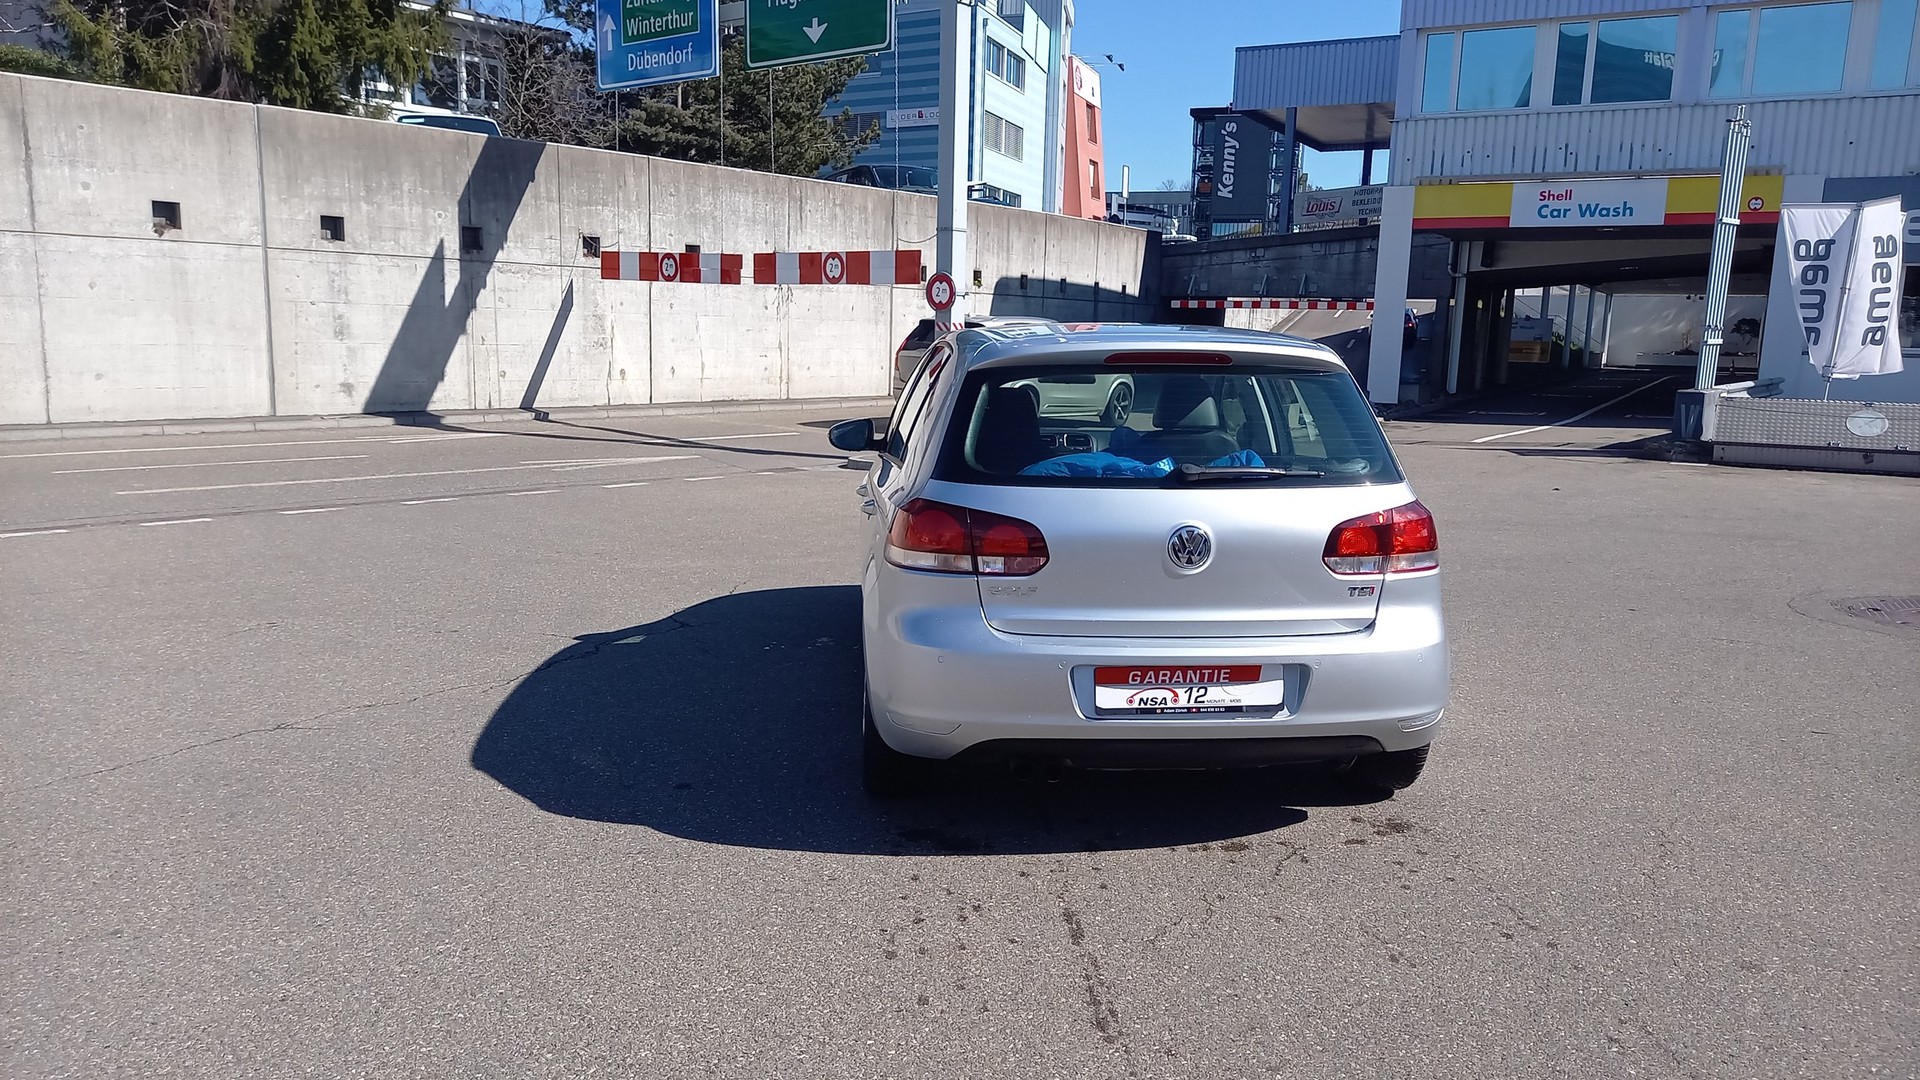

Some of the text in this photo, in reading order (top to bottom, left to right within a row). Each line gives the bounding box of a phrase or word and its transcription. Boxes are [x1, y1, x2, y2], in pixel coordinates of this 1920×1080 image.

[626, 9, 694, 38] Winterthur
[628, 42, 693, 72] Dübendorf
[1217, 121, 1240, 199] Kenny's
[1539, 189, 1573, 202] Shell
[1306, 199, 1337, 214] Louis
[1537, 200, 1634, 219] Car Wash
[1128, 669, 1231, 685] GARANTIE
[1138, 697, 1168, 707] NSA
[1184, 686, 1208, 704] 12
